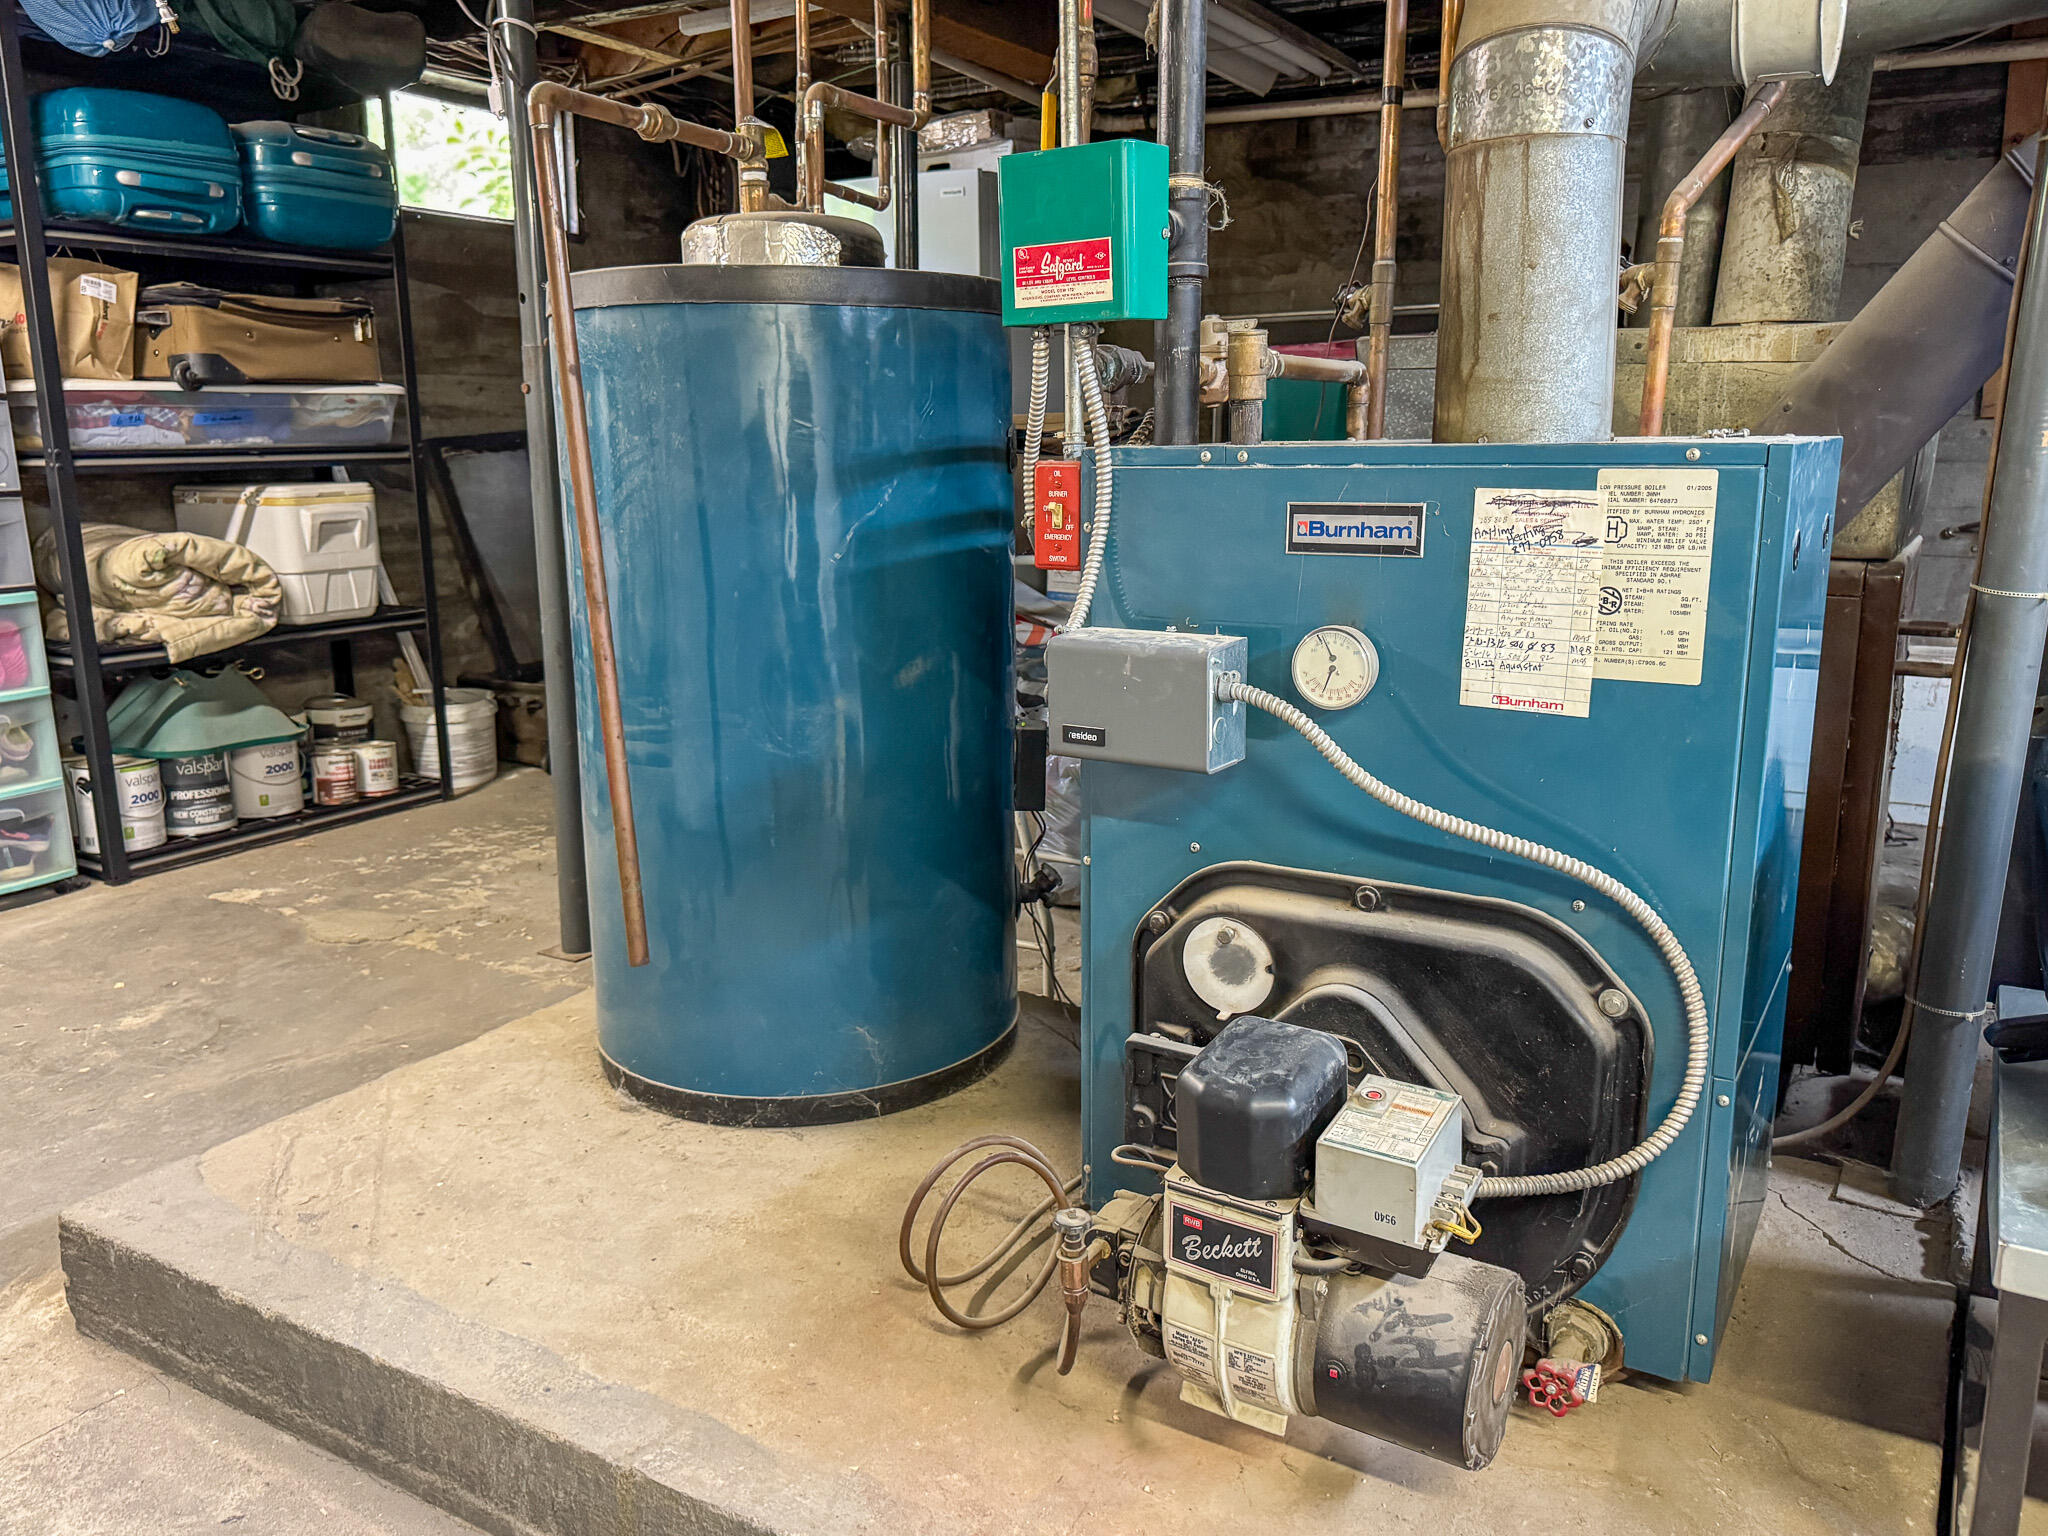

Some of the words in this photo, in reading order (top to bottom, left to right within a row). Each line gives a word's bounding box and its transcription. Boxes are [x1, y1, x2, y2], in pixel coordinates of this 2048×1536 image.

[1040, 252, 1084, 281] Safgard
[1309, 521, 1412, 539] Burnham
[1499, 695, 1564, 710] Burnham
[265, 760, 293, 774] 2000
[131, 790, 158, 804] 2000
[1184, 1216, 1201, 1227] RWB
[1374, 1211, 1396, 1225] 9540
[1182, 1234, 1262, 1260] Beckett
